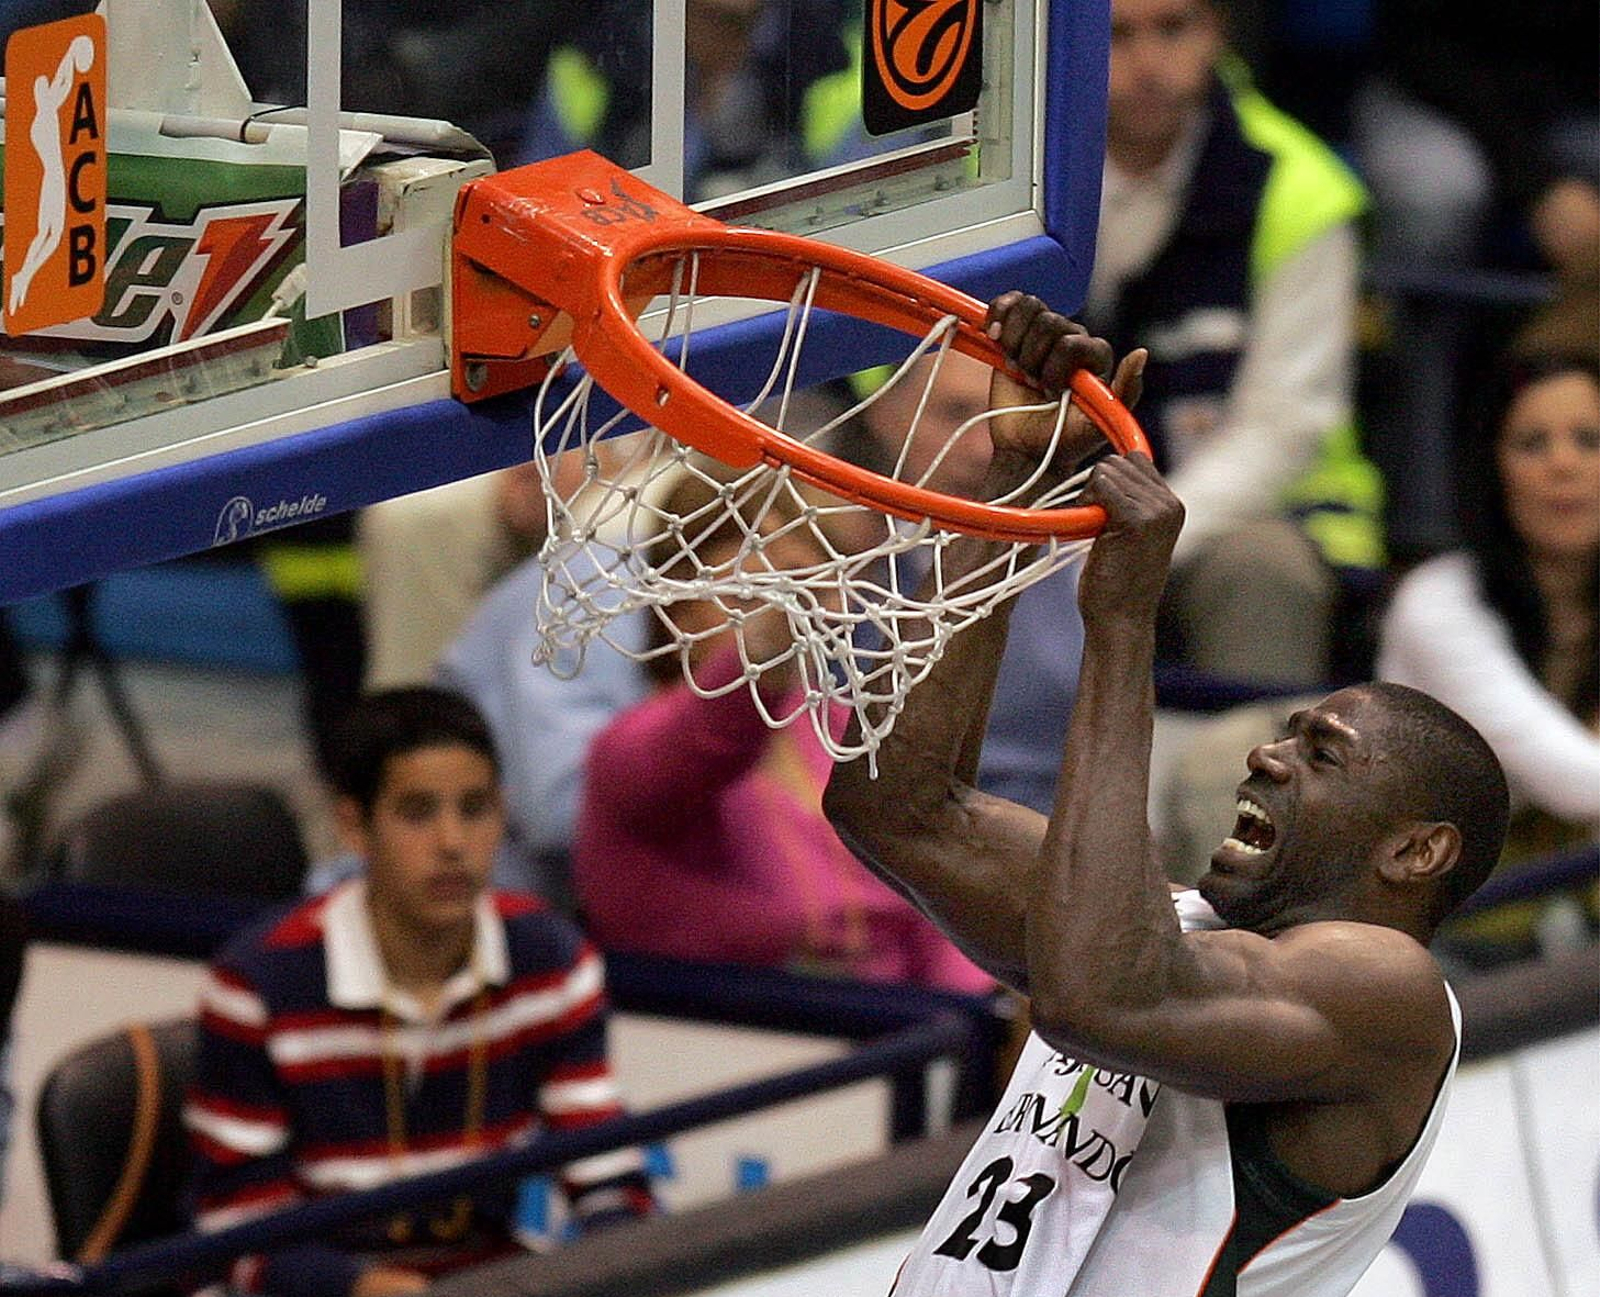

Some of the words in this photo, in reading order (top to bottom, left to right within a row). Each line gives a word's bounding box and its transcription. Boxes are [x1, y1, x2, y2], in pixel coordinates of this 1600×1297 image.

[68, 81, 99, 288] ACB
[254, 493, 328, 526] schelde
[932, 1154, 1057, 1272] 23
